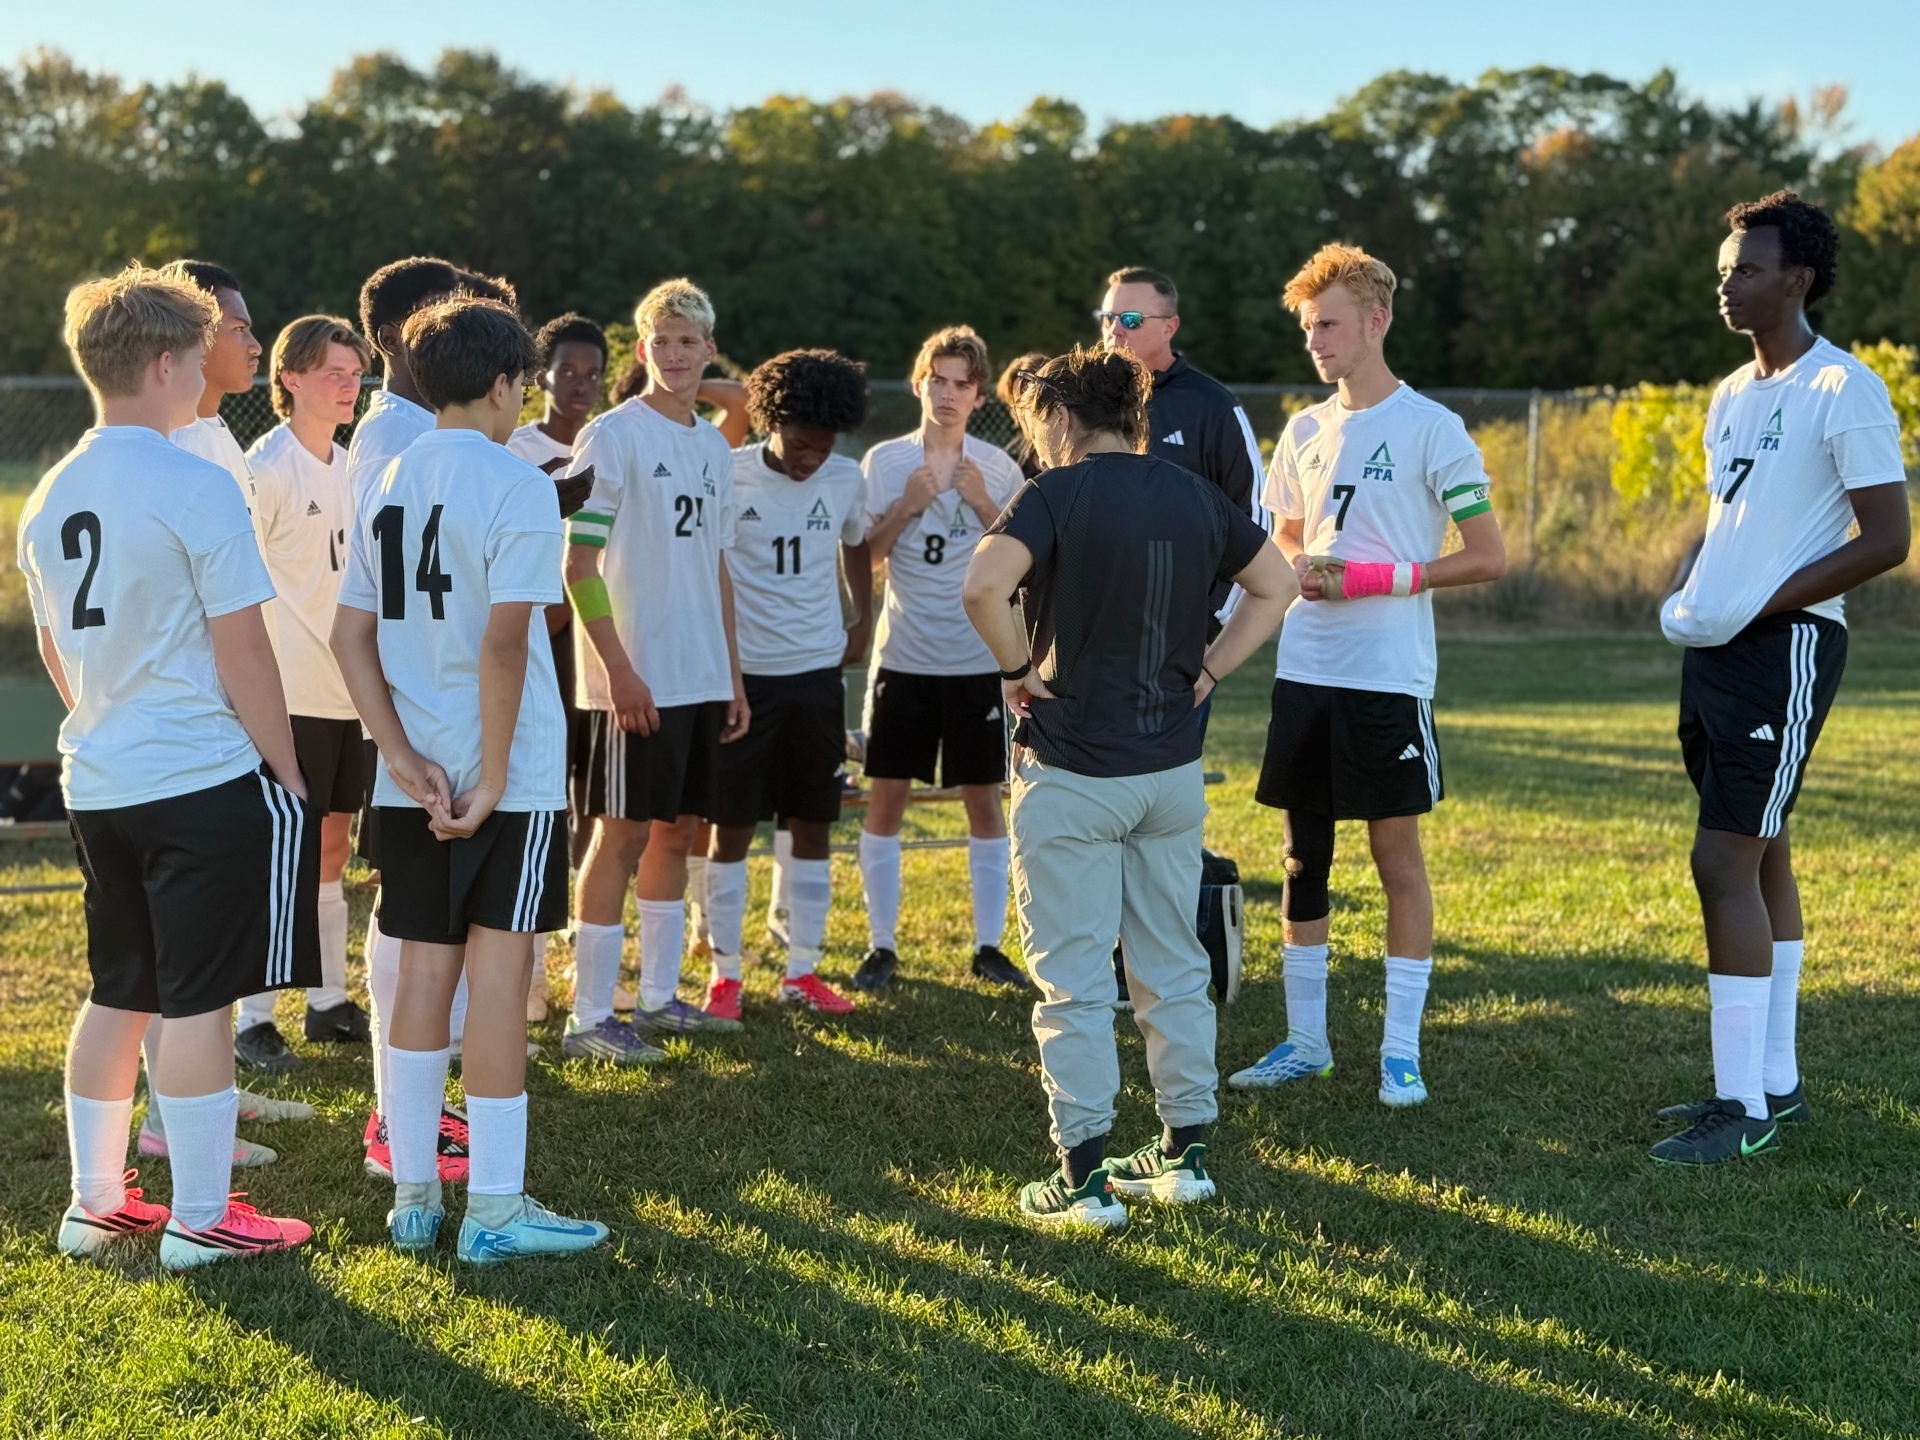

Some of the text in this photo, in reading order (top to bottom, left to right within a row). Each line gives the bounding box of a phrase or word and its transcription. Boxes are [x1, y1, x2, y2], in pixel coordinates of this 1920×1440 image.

[1362, 466, 1393, 482] PTA
[806, 519, 831, 531] PTA
[1333, 484, 1356, 532] 7
[372, 504, 452, 621] 14
[772, 535, 801, 575] 11
[923, 533, 945, 566] 8
[61, 510, 106, 630] 2
